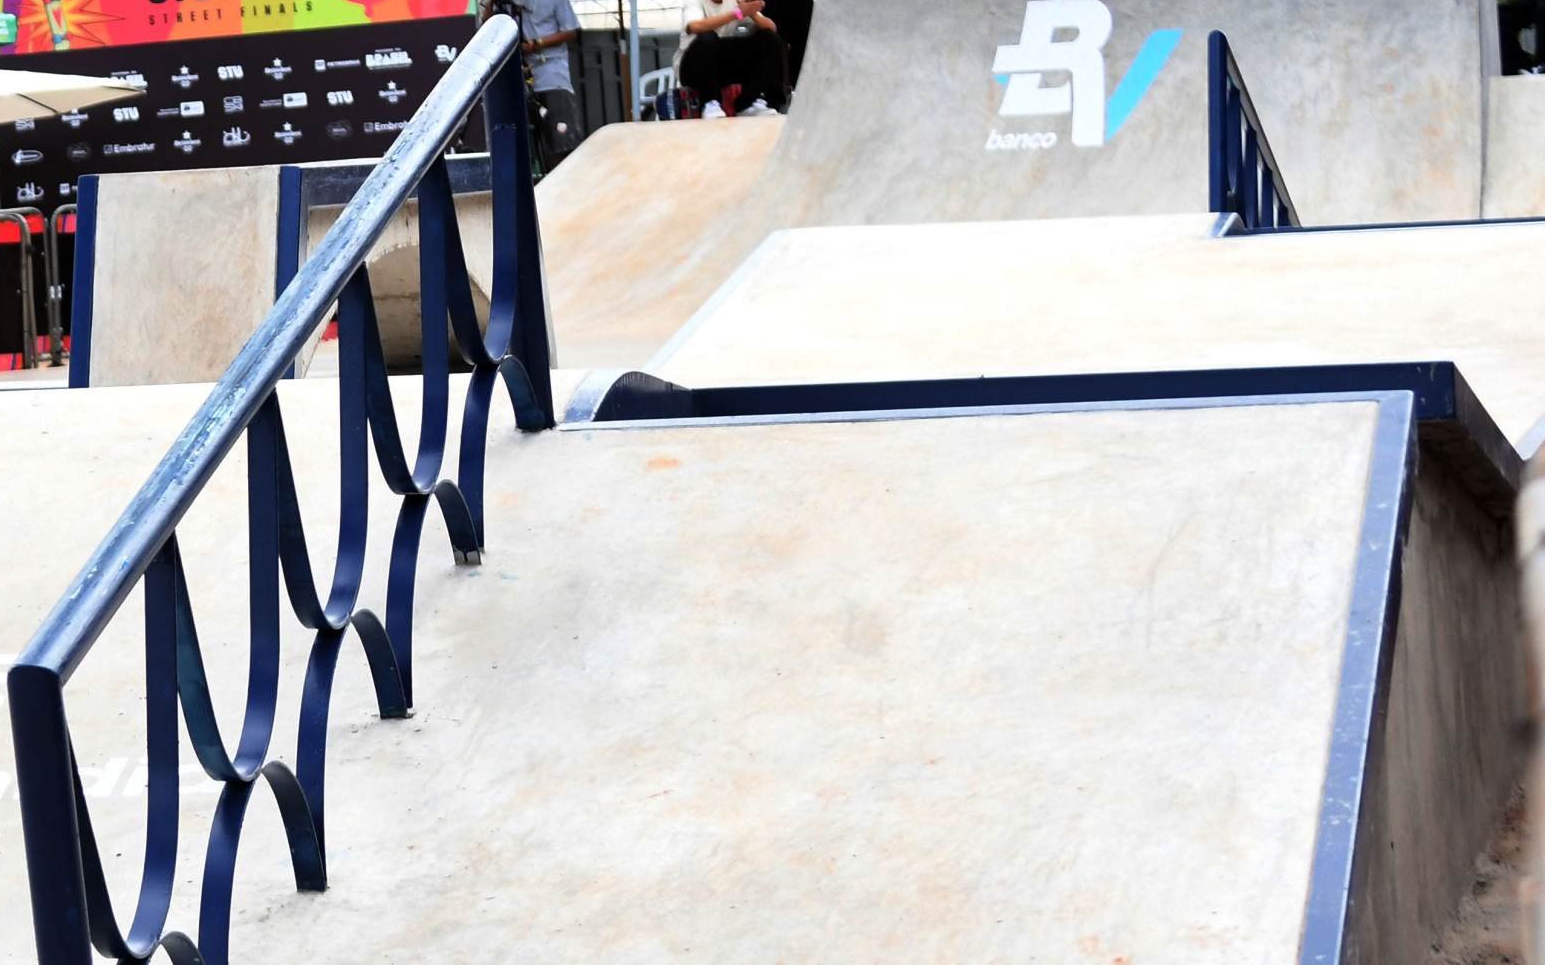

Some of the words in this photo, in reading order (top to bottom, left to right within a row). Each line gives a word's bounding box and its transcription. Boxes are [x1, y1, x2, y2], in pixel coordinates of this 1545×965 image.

[149, 7, 223, 26] STREET
[240, 0, 314, 18] FINALS
[217, 65, 244, 80] STU
[327, 91, 354, 106] STU
[113, 107, 140, 122] STU
[984, 128, 1058, 151] banco
